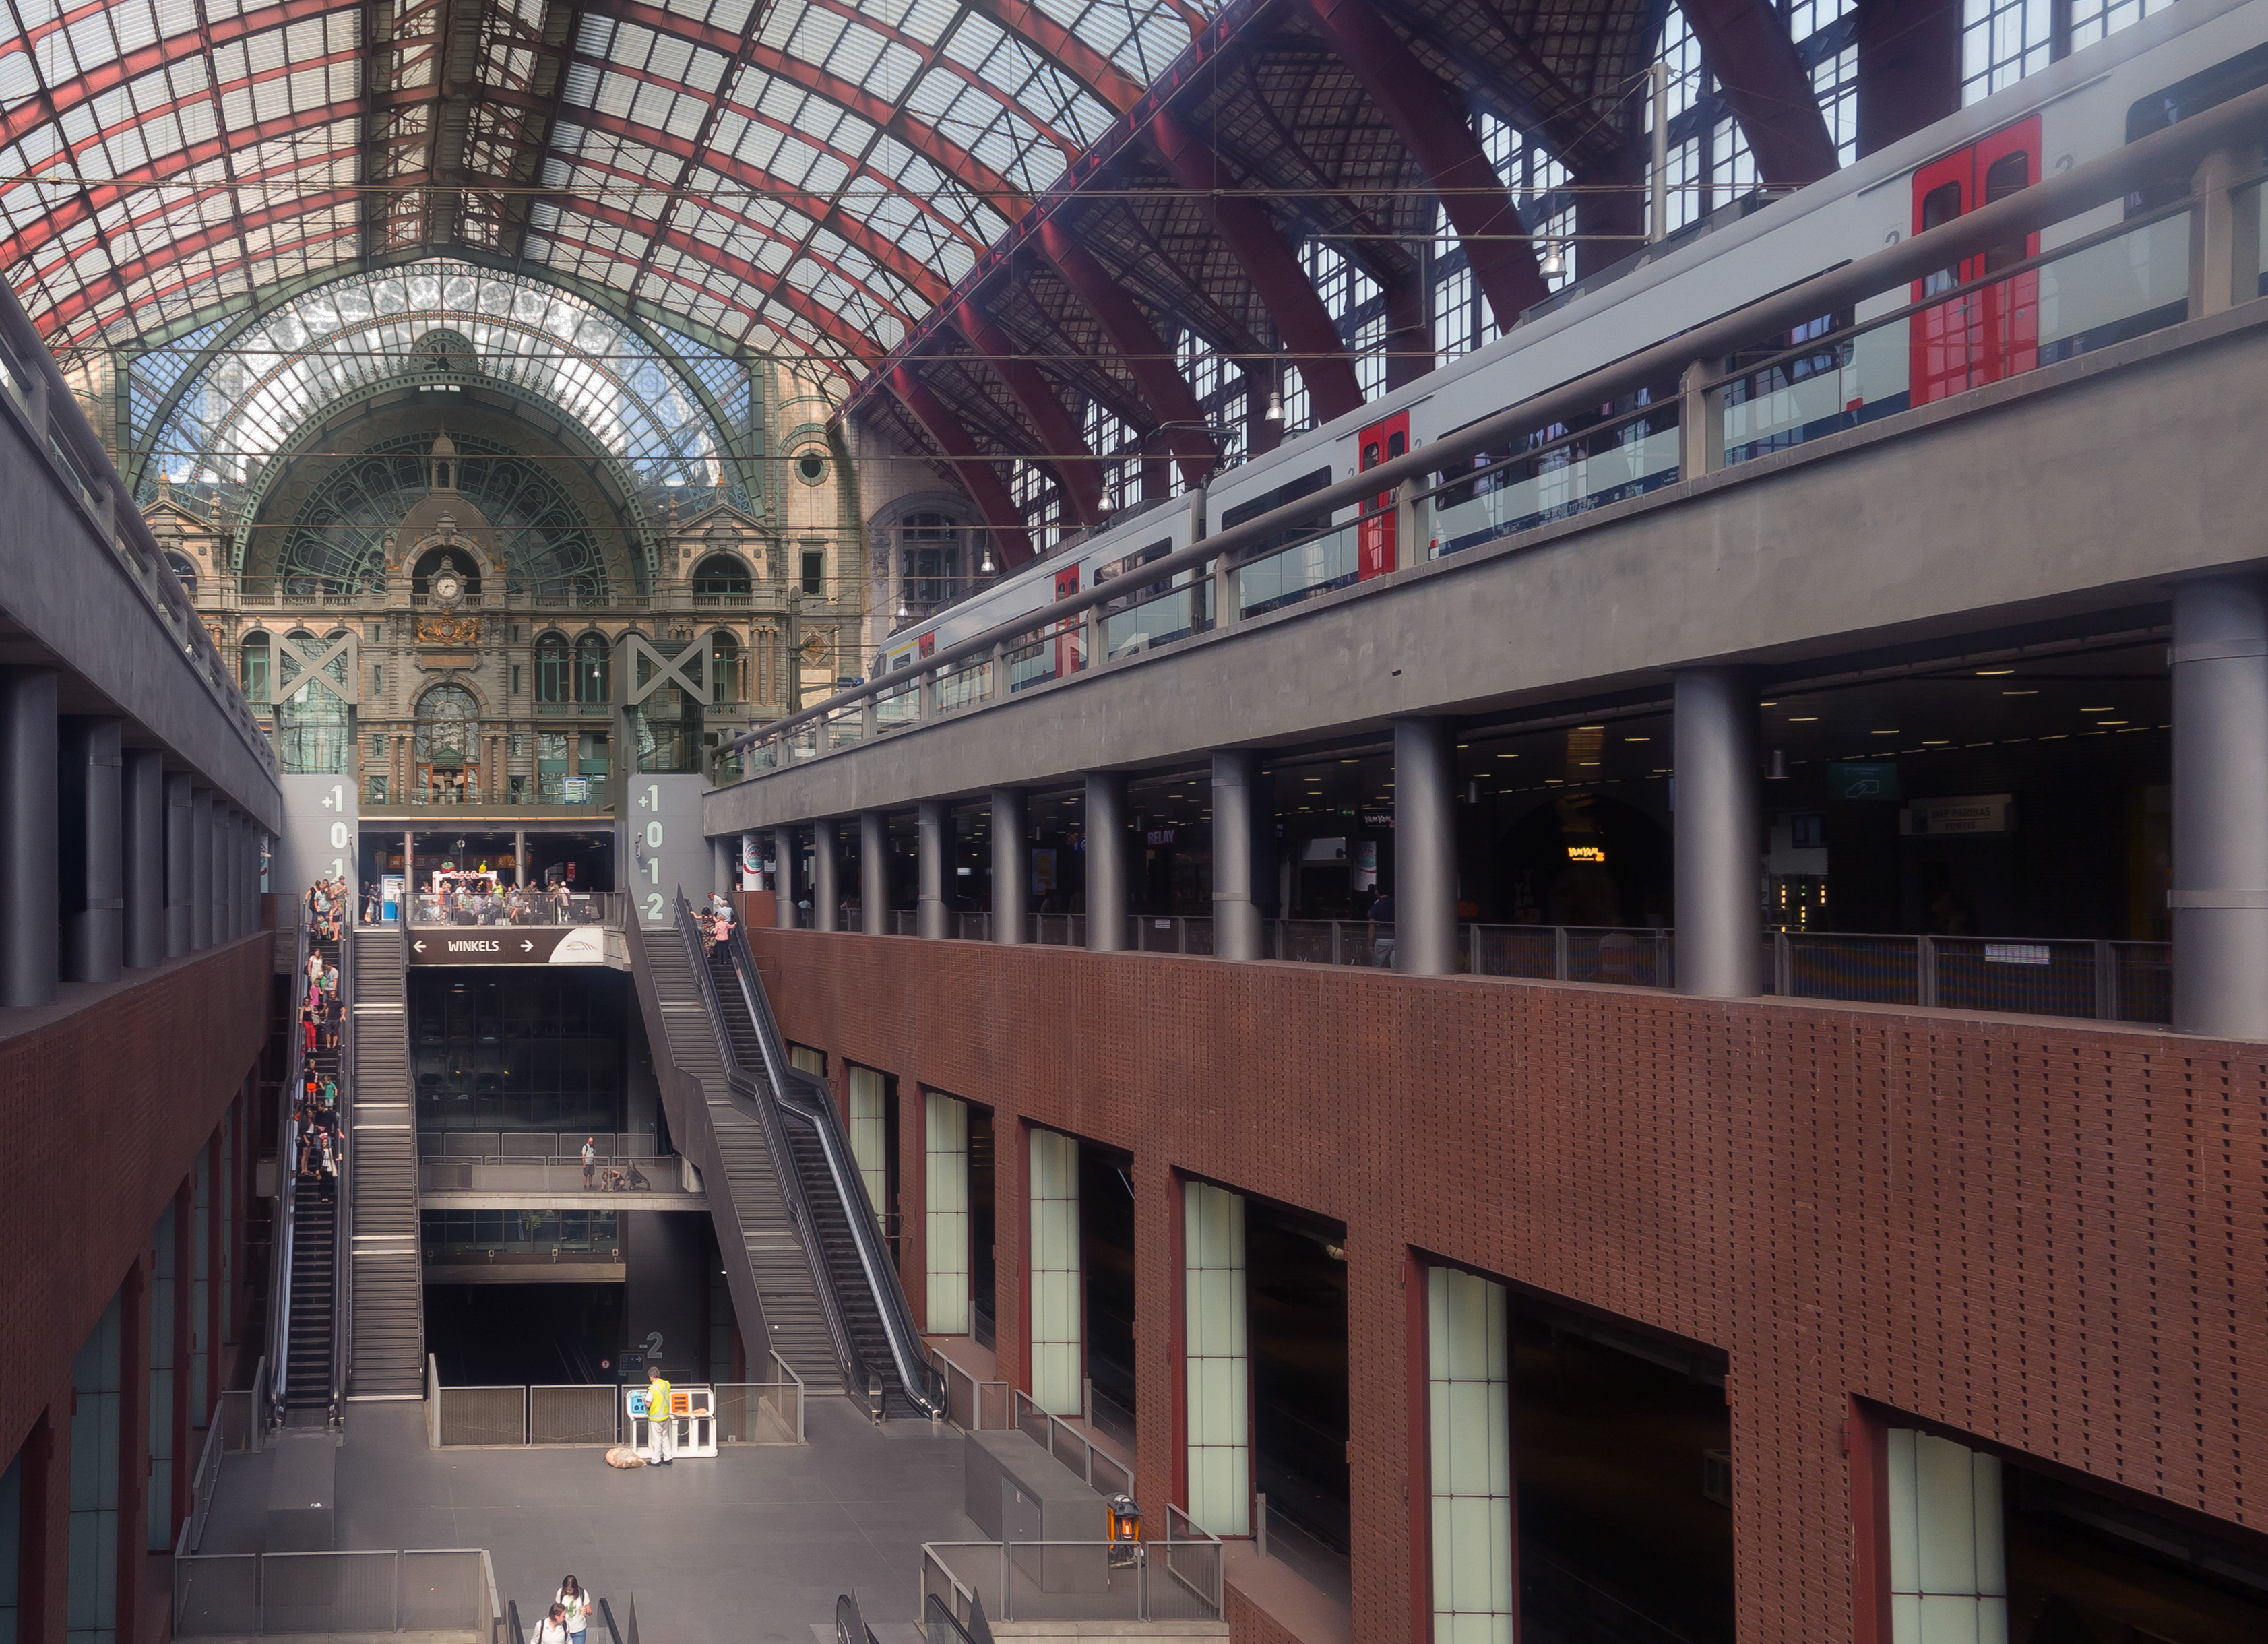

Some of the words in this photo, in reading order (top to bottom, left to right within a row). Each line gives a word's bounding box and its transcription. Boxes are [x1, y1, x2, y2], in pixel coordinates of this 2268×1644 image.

[321, 784, 343, 813] +1
[638, 784, 658, 812] +1
[330, 821, 348, 849] 0
[647, 821, 663, 848] 0
[1147, 829, 1174, 845] RELAY
[641, 857, 658, 884] -1
[640, 893, 664, 920] -2
[447, 940, 499, 952] WINKELS
[639, 1331, 663, 1359] -2
